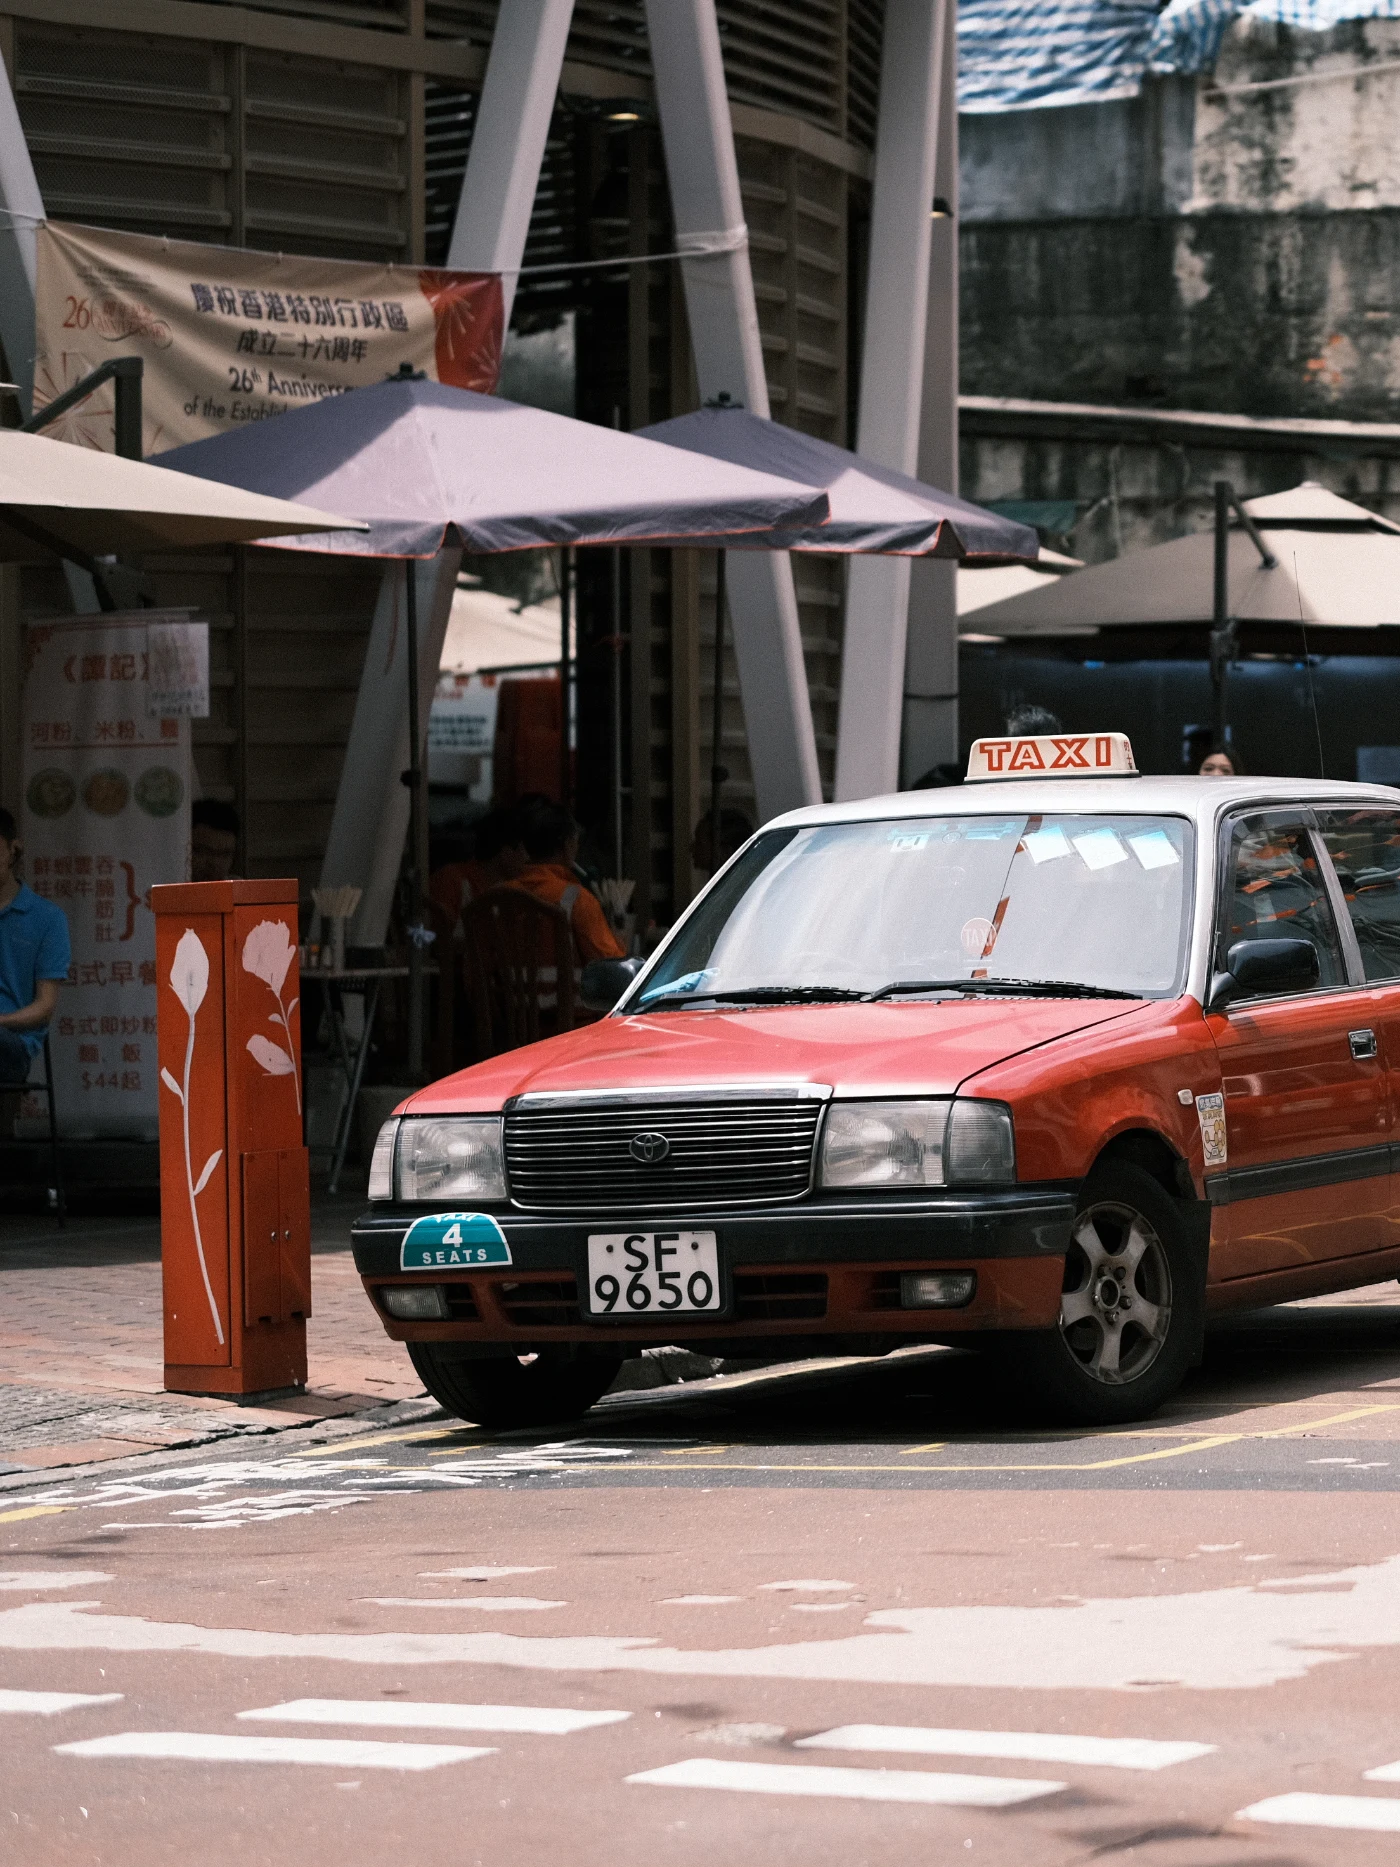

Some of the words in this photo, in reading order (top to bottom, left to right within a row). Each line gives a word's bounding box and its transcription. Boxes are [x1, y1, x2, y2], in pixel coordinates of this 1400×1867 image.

[190, 282, 410, 332] 慶祝香港特別行政區
[236, 328, 369, 363] 成立二十六周年
[184, 395, 200, 417] of
[203, 397, 226, 419] the
[979, 736, 1112, 771] TAXI
[442, 1223, 463, 1247] 4
[422, 1249, 487, 1265] SEATS
[623, 1234, 681, 1273] SF
[594, 1270, 715, 1312] 9650
